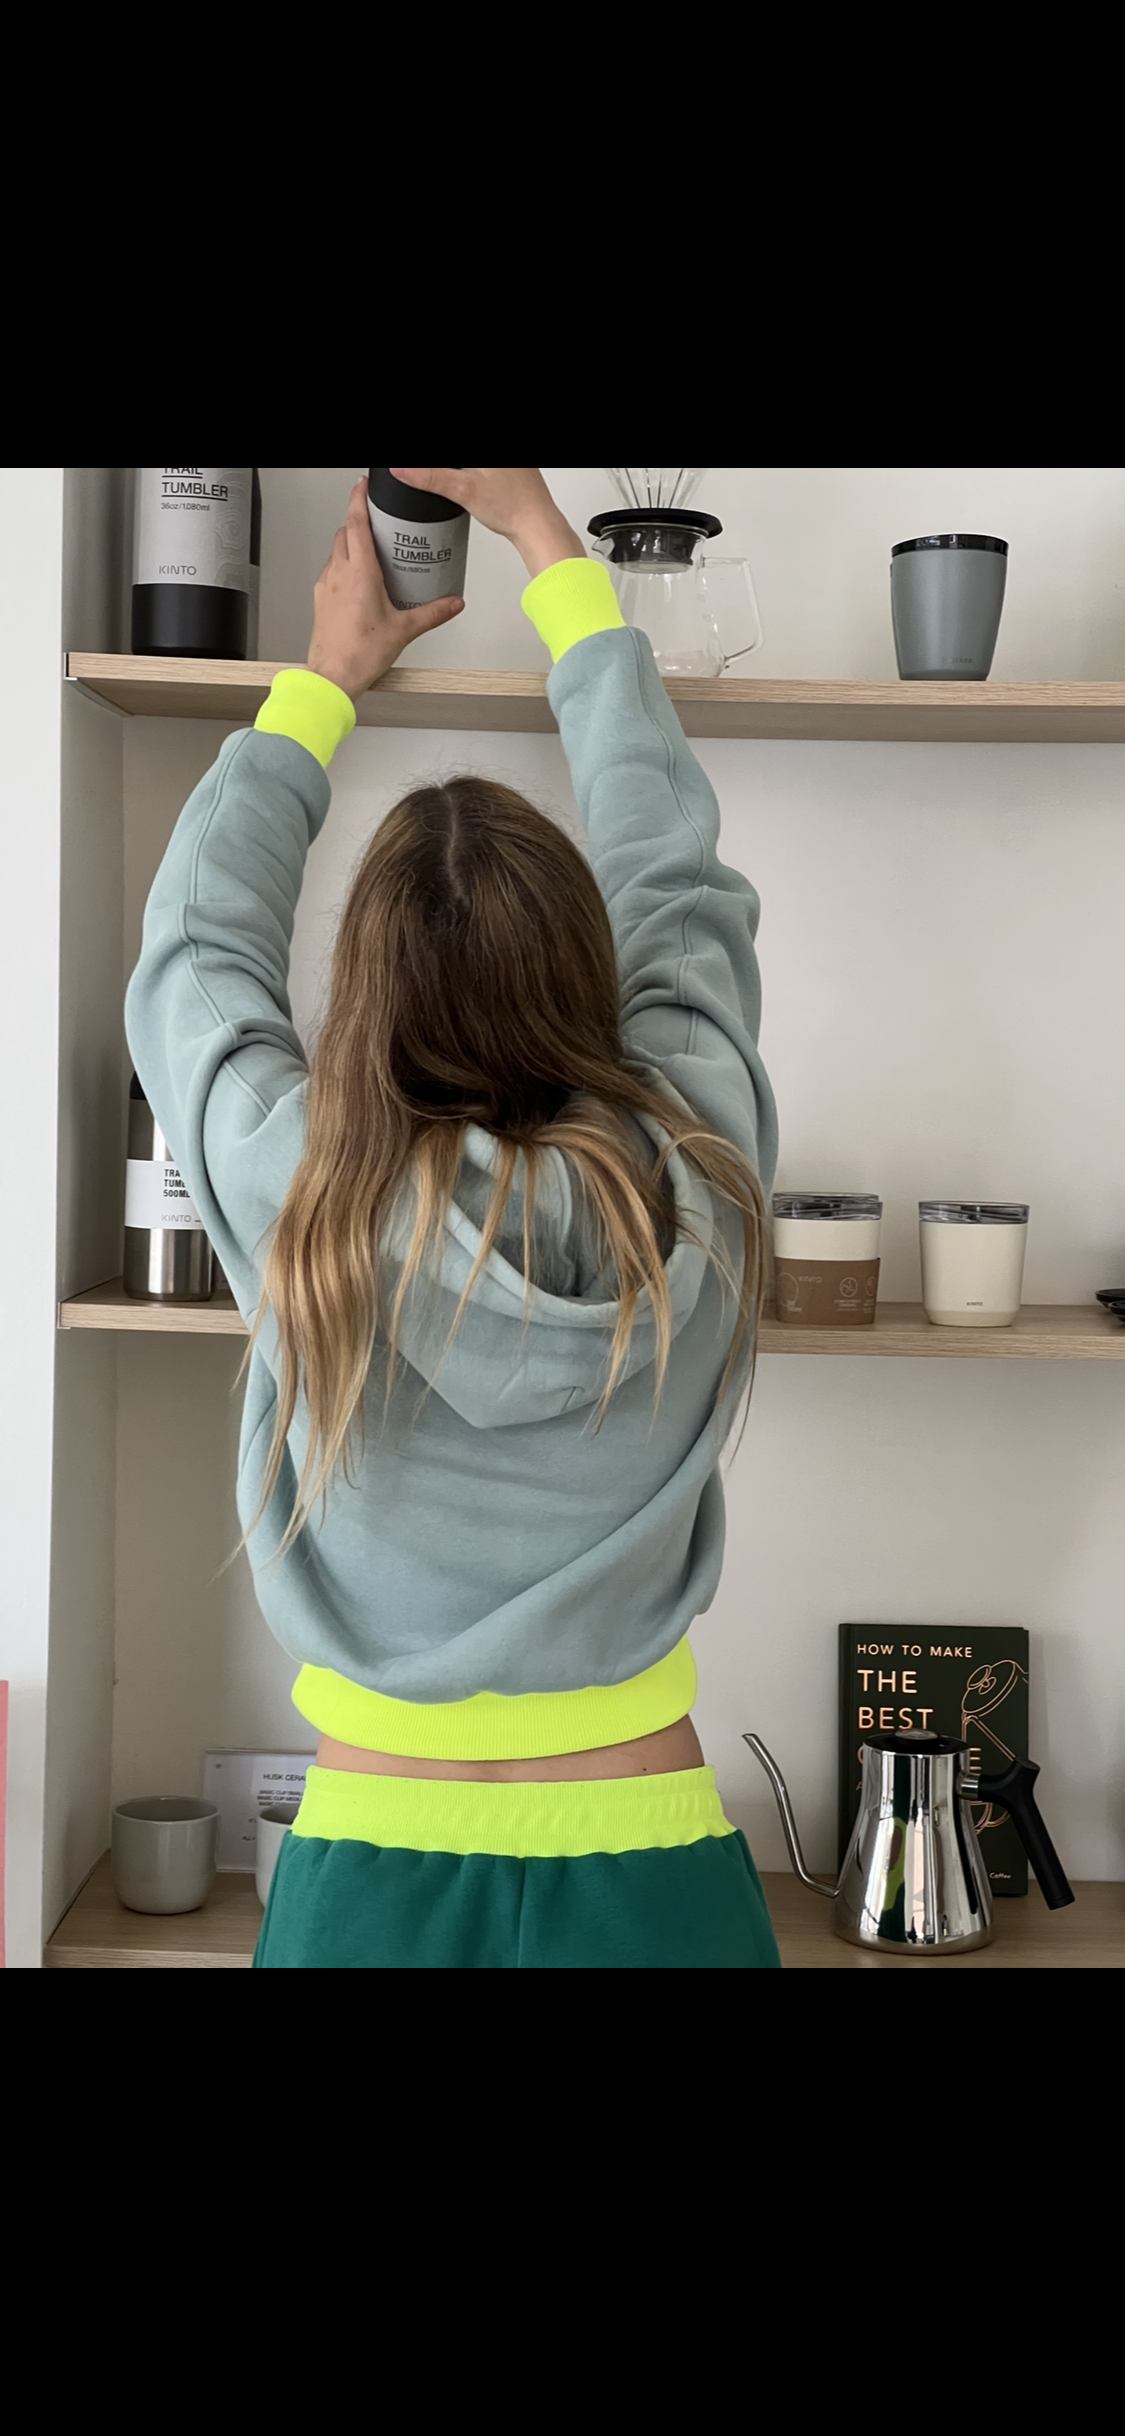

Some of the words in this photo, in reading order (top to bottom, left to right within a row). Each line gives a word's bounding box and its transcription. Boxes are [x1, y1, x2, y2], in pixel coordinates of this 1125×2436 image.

[161, 481, 229, 498] TUMBLER
[394, 531, 431, 546] TRAIL
[393, 547, 452, 561] TUMBLER
[158, 565, 197, 576] KINTO
[163, 1168, 181, 1178] TRA
[162, 1189, 191, 1198] 500ML
[161, 1214, 192, 1223] KINTO
[857, 1643, 894, 1656] HOW
[902, 1645, 922, 1657] TO
[930, 1646, 973, 1659] MAKE
[857, 1669, 918, 1694] THE
[858, 1706, 934, 1730] BEST
[263, 1773, 284, 1781] HUSK
[284, 1774, 307, 1782] CERA
